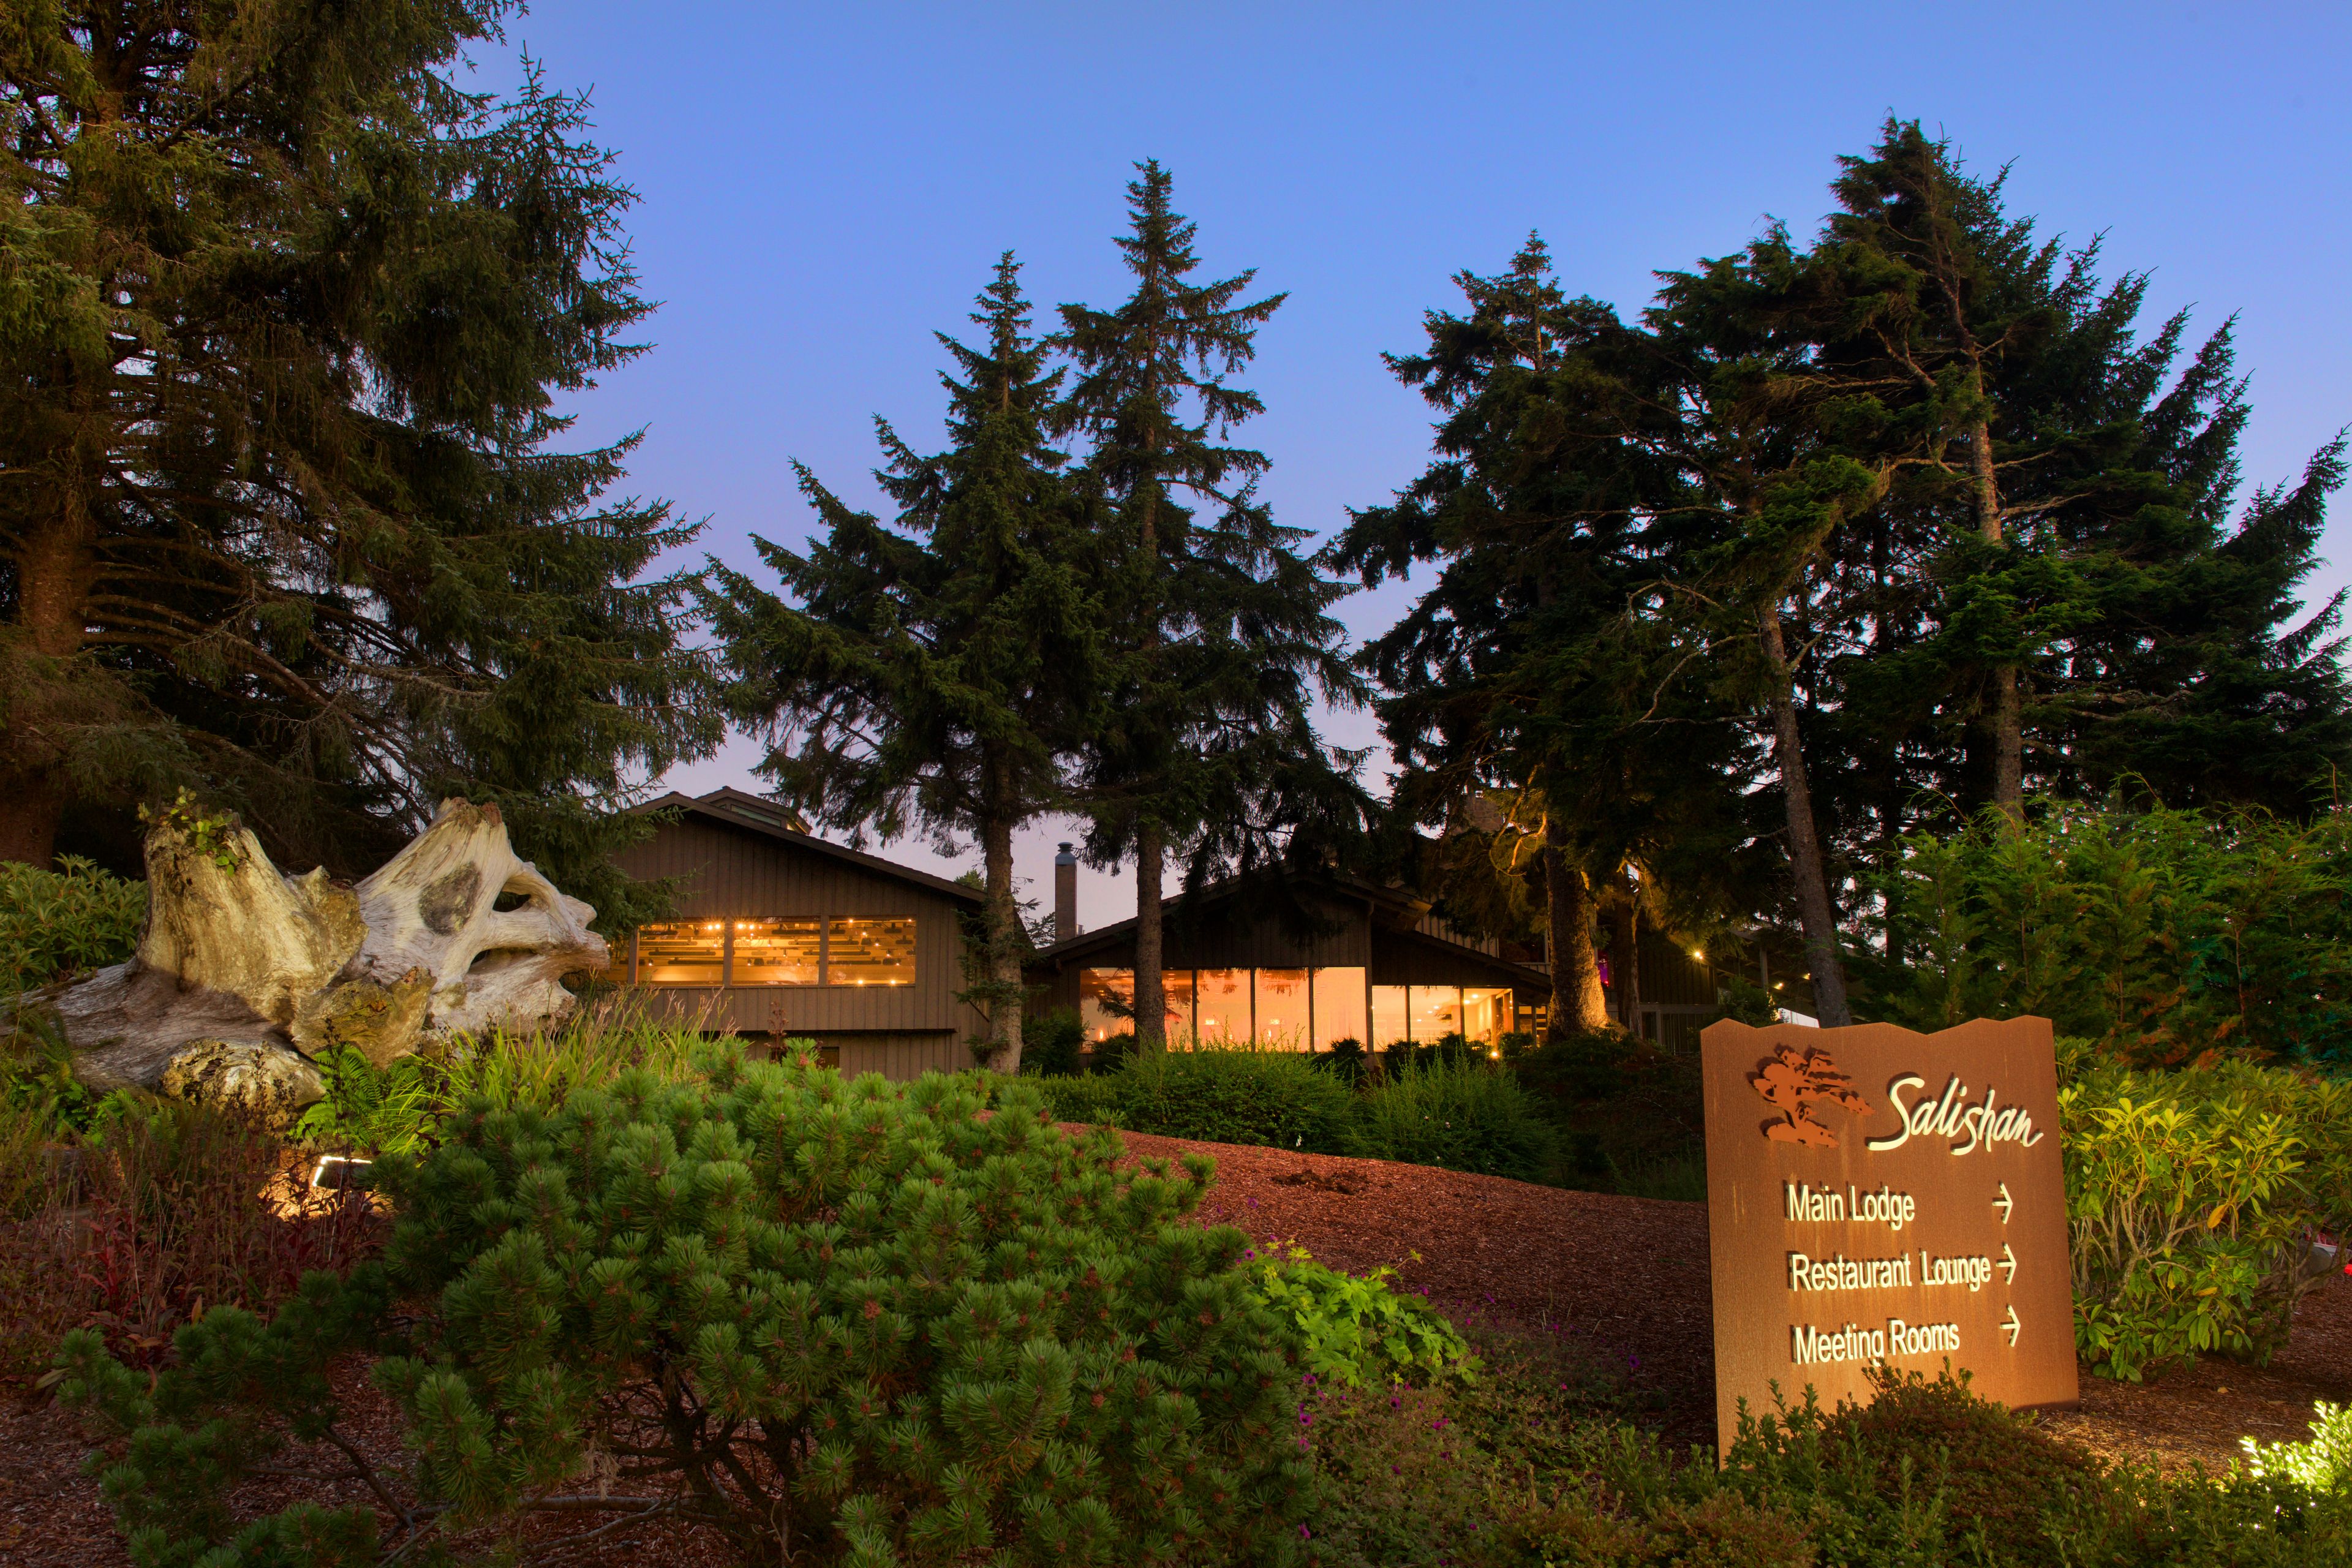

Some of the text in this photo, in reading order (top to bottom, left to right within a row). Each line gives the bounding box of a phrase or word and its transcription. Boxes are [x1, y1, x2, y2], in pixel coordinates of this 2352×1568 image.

[1869, 1077, 2044, 1156] Salishan
[1788, 1184, 1915, 1231] Main Lodge
[1792, 1250, 1991, 1293] Restaurant Lounge
[1795, 1319, 1961, 1368] Meeting Rooms
